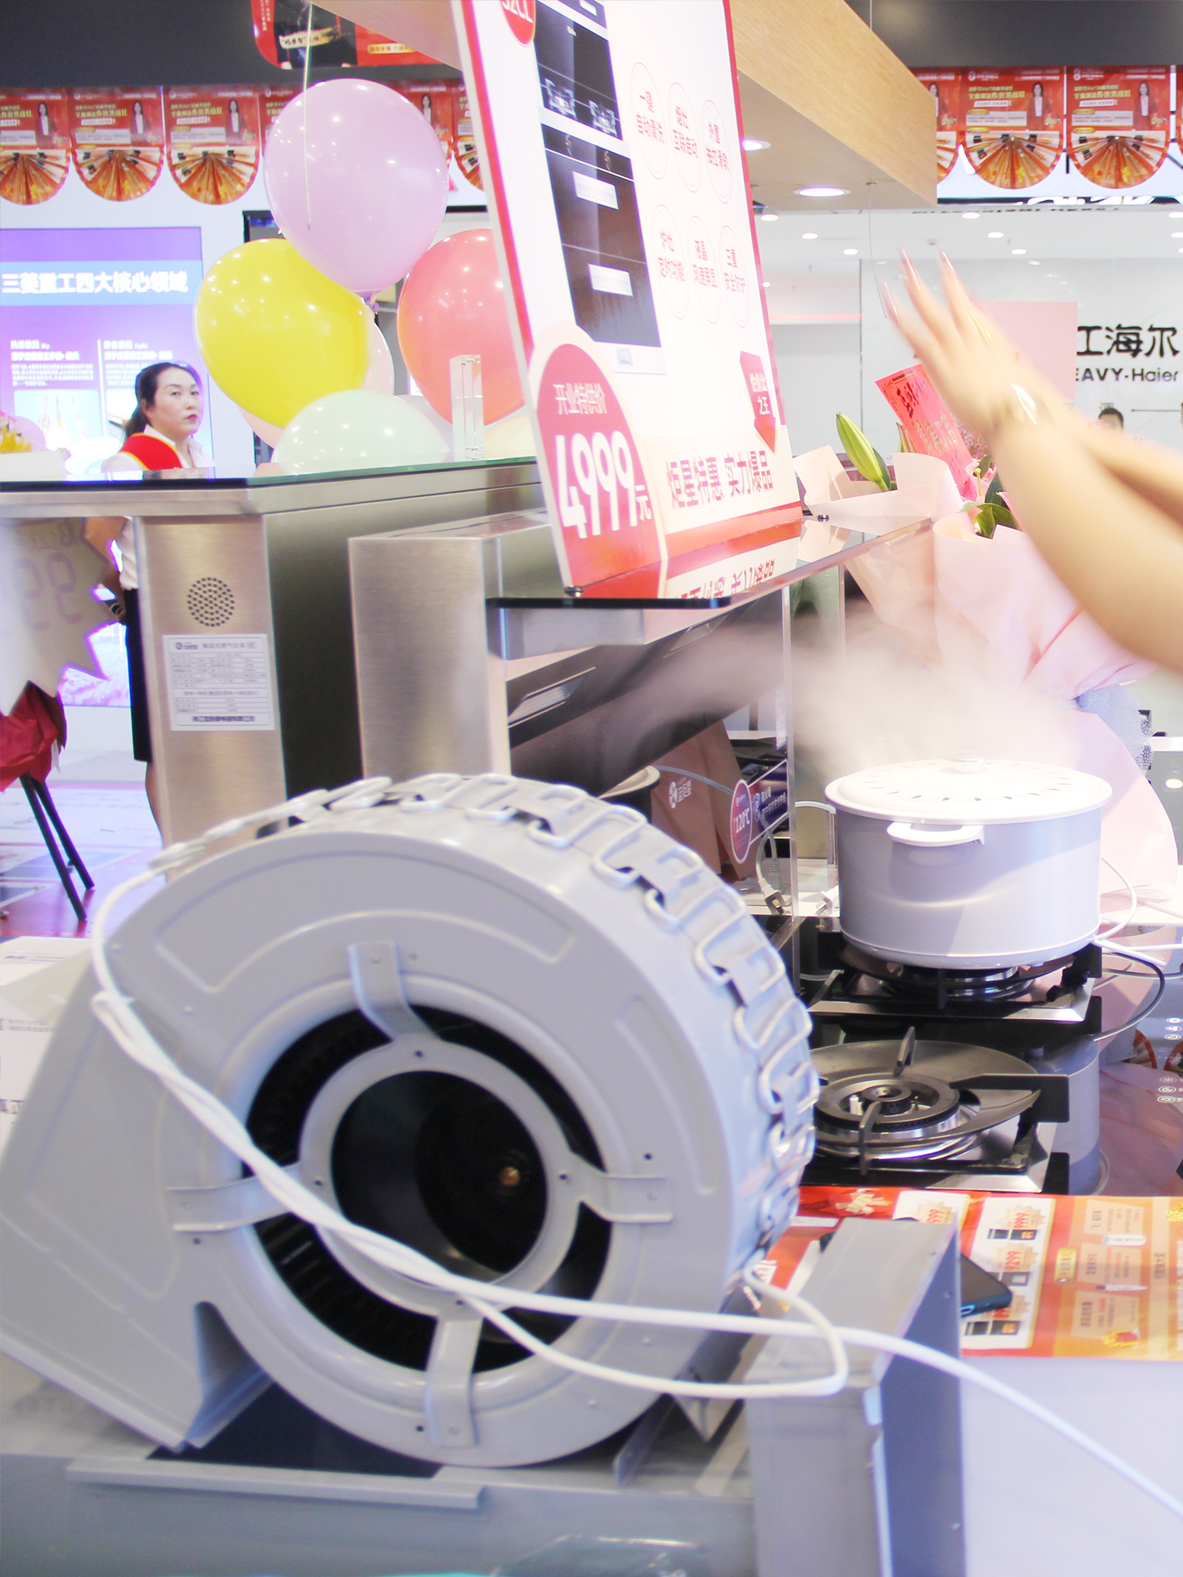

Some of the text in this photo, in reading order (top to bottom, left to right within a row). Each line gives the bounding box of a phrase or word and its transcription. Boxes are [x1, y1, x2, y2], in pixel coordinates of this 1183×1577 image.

[2, 271, 189, 294] 三菱重工四大核心领域
[1077, 323, 1179, 358] 工海尔
[553, 382, 608, 416] 开业特供价
[757, 396, 770, 414] 之王
[665, 450, 773, 510] 炬星特惠 实力爆品
